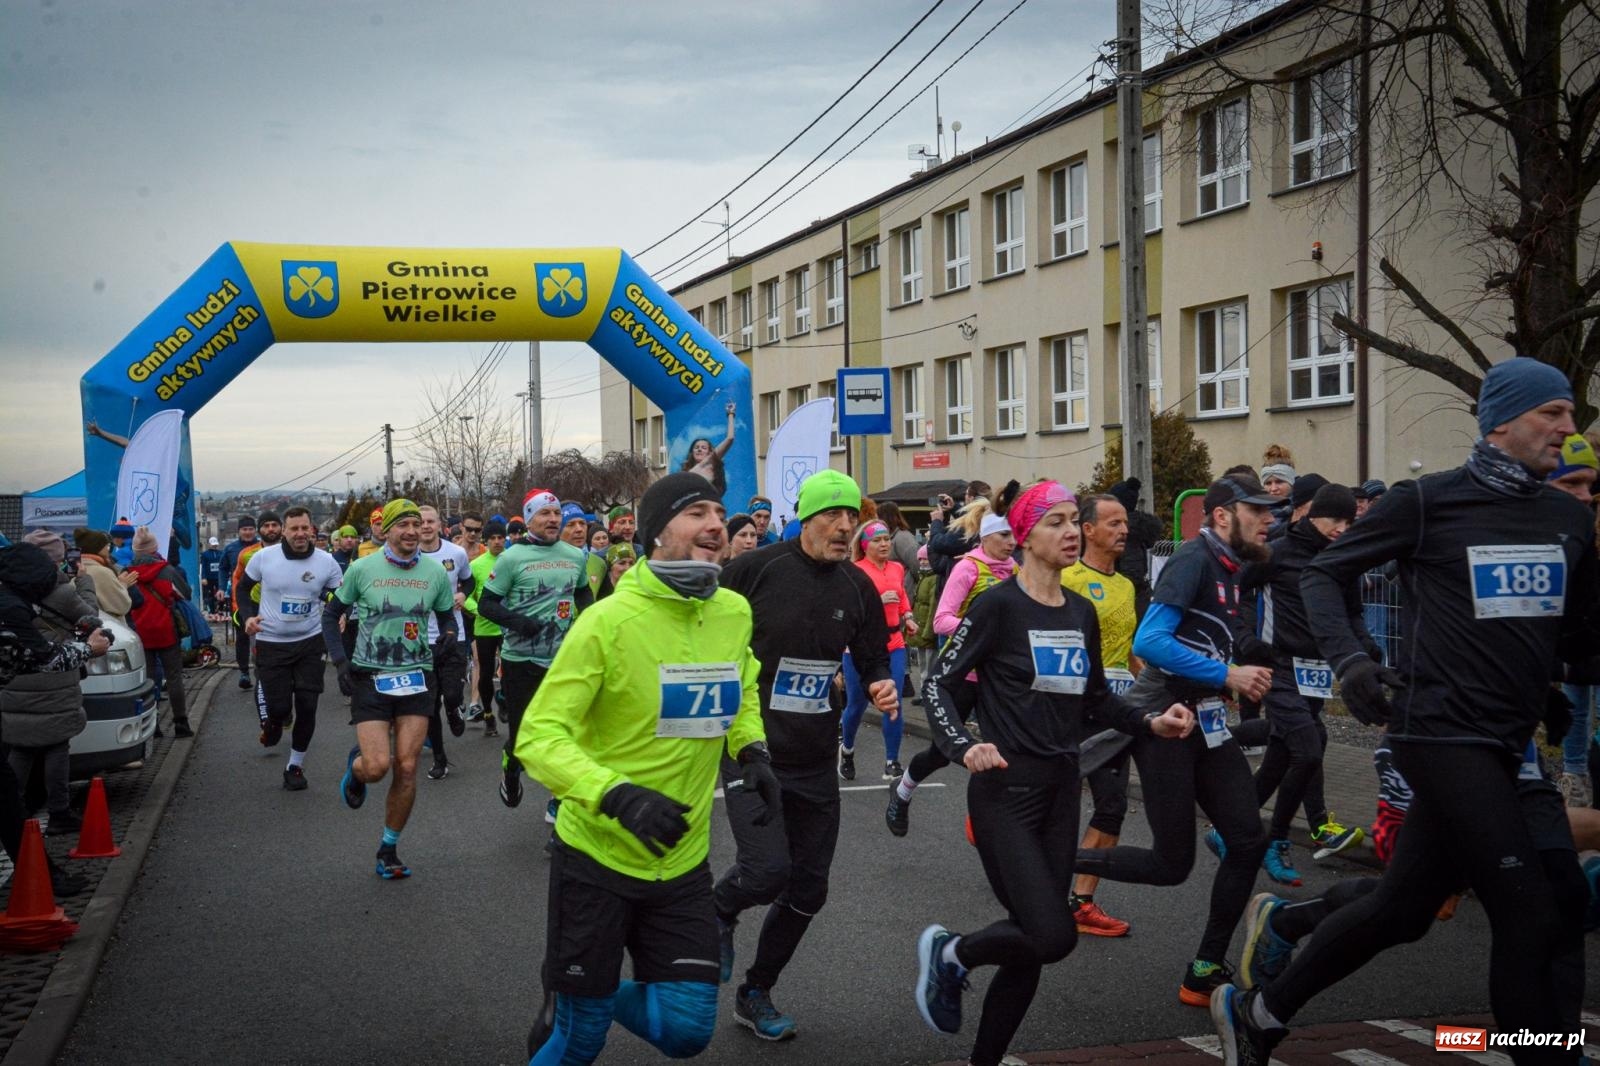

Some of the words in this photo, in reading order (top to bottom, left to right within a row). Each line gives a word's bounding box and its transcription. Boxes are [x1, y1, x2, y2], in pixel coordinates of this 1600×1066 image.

[387, 261, 489, 277] Gmina
[362, 281, 517, 301] Pietrowice
[382, 304, 497, 323] Wielkie
[127, 326, 194, 382] Gmina
[186, 279, 241, 329] ludzi
[625, 282, 679, 338] Gmina
[679, 331, 724, 377] ludzi
[155, 304, 260, 400] aktywnych
[610, 306, 704, 394] aktywnych
[373, 578, 428, 590] CURSORES
[1491, 564, 1552, 595] 188
[286, 603, 309, 614] 140
[1053, 649, 1084, 675] 76
[390, 675, 411, 689] 18
[787, 674, 829, 698] 187
[1300, 670, 1328, 687] 133
[687, 684, 723, 716] 71
